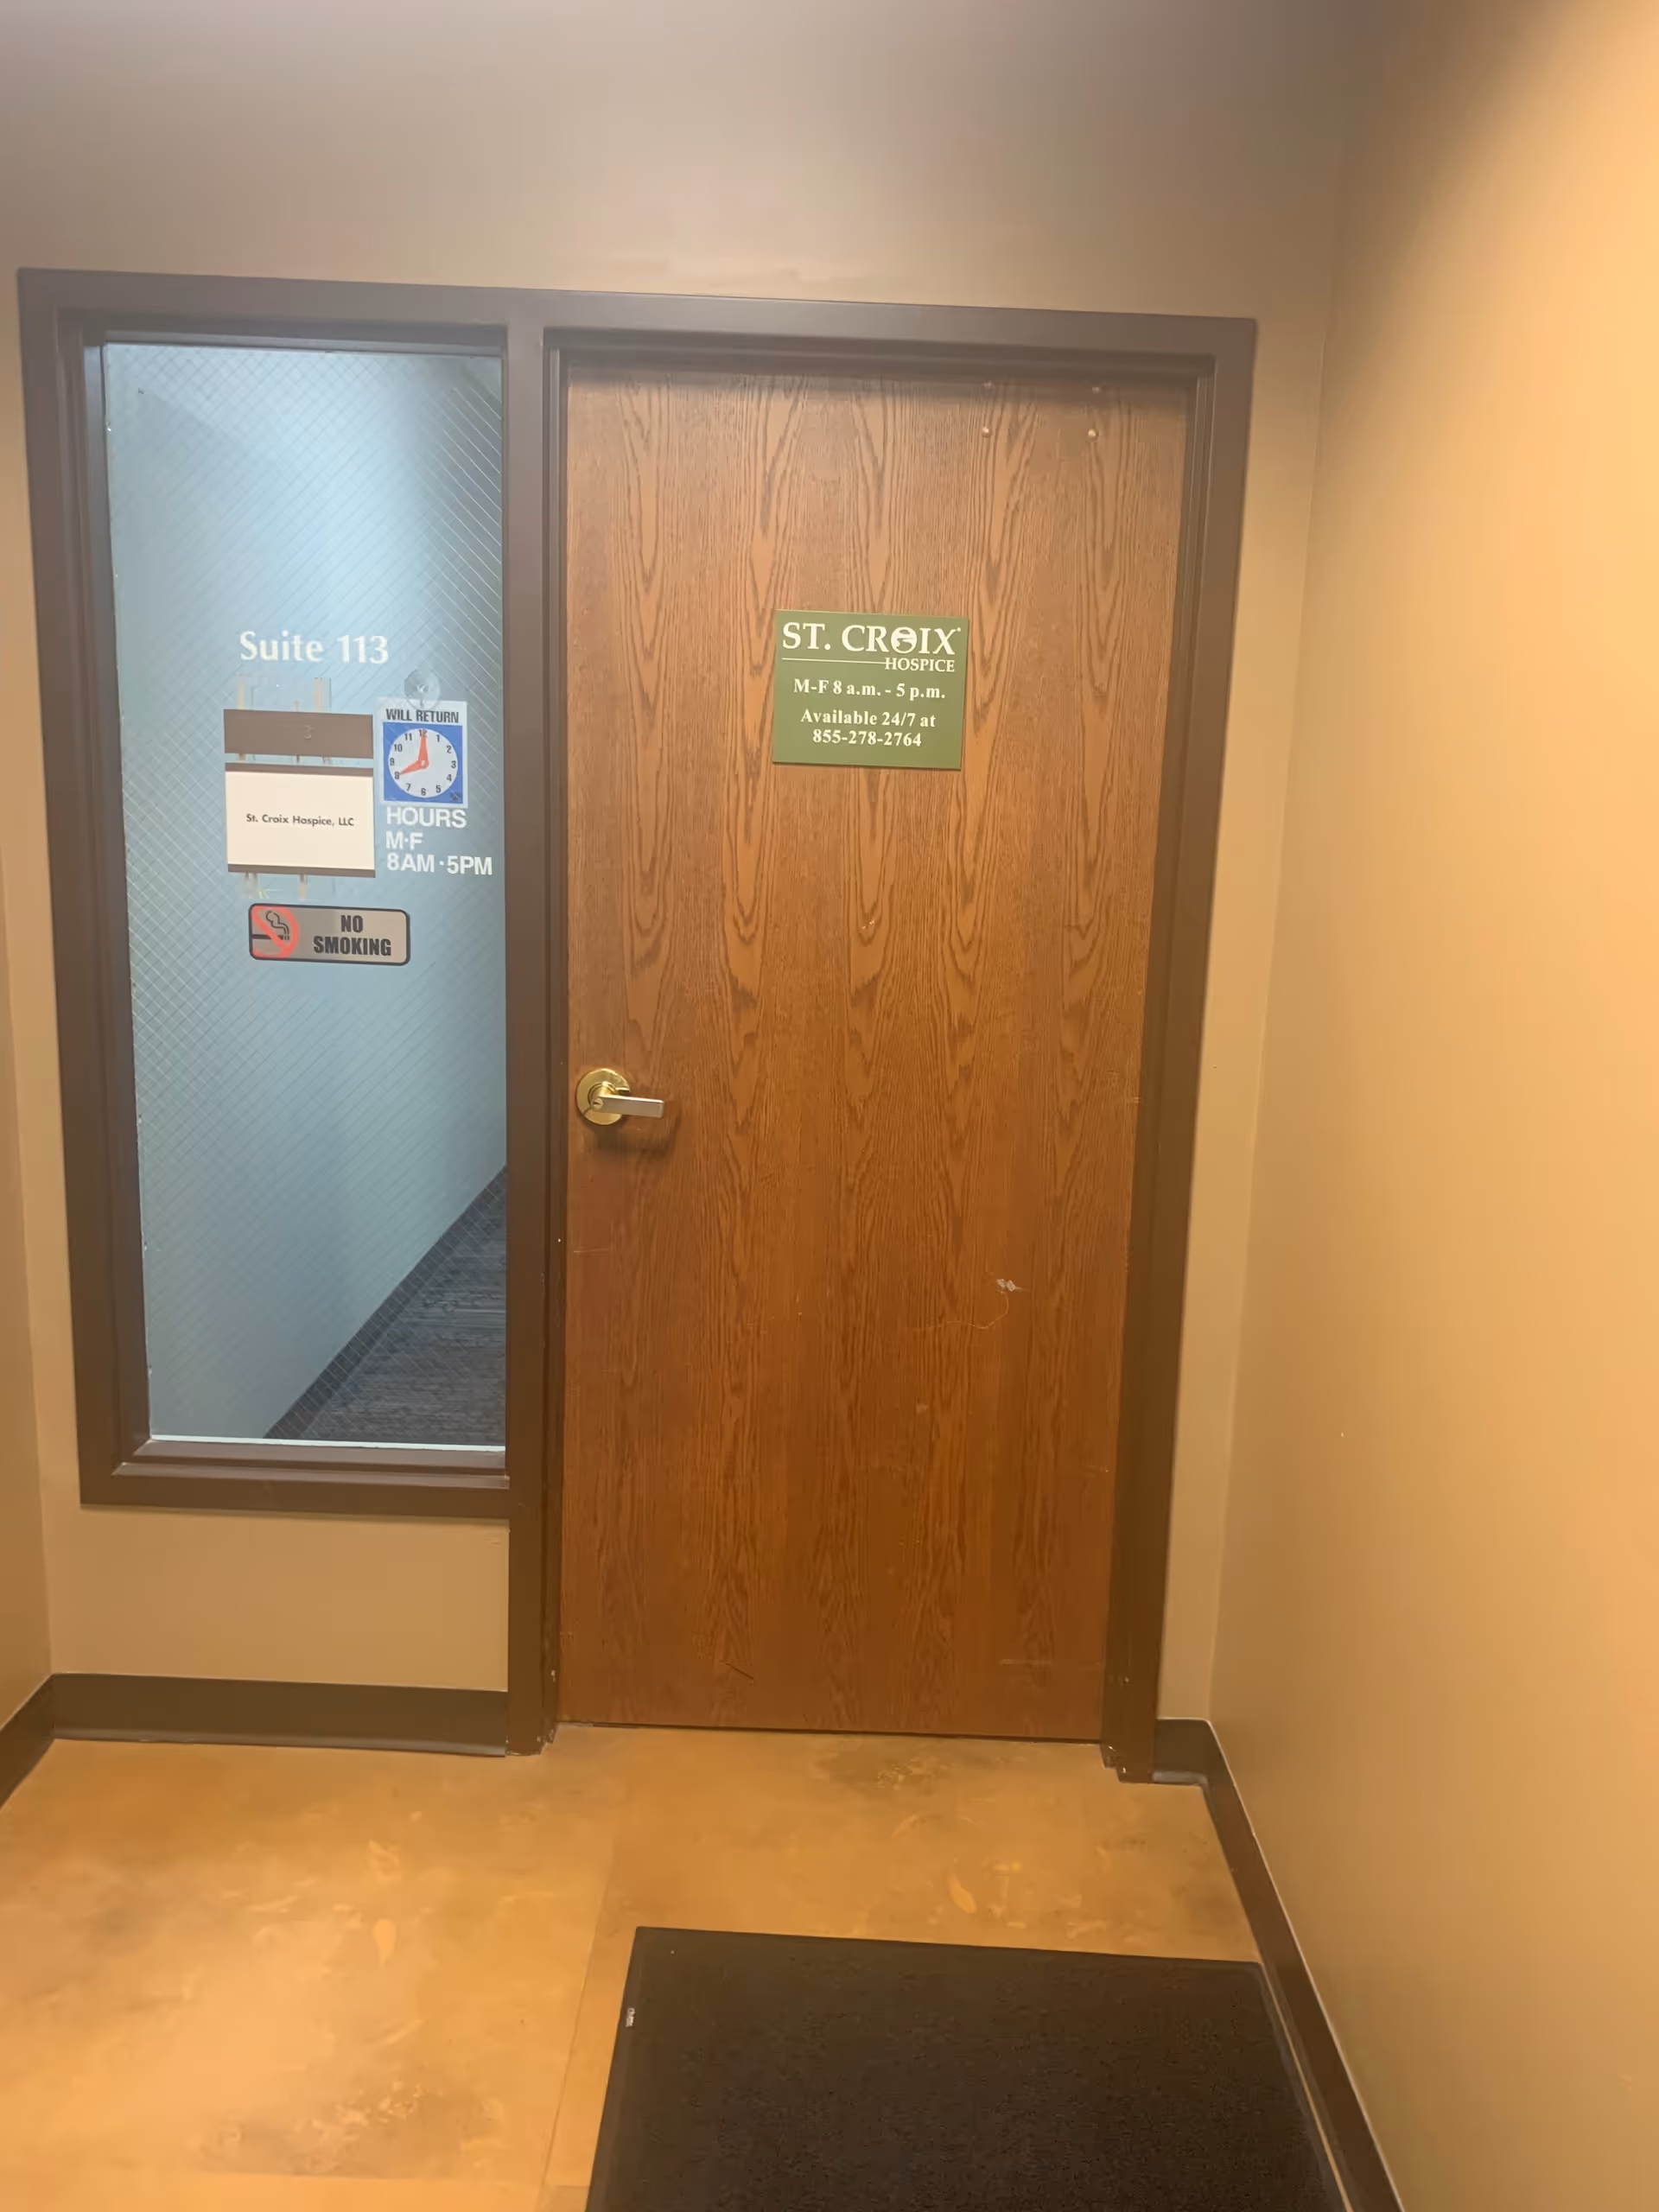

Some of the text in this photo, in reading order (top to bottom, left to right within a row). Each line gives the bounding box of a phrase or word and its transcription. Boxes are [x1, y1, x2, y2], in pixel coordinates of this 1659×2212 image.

[782, 621, 956, 655] ST. CROIX
[239, 629, 390, 664] Suite 113
[884, 657, 956, 673] HOSPICE
[793, 678, 830, 694] M-F
[832, 680, 842, 695] 8
[846, 683, 881, 696] a.m.
[896, 683, 906, 697] 5
[909, 686, 946, 702] p.m.
[385, 709, 459, 724] WILL RETURN
[800, 709, 937, 728] Available 24/7 at
[404, 733, 412, 741] 11
[436, 734, 440, 743] 1
[812, 728, 922, 747] 855-278-2764
[394, 744, 403, 753] 10
[446, 745, 452, 754] 2
[390, 758, 395, 766] 9
[451, 760, 456, 769] 3
[394, 772, 400, 780] 8
[446, 774, 453, 783] 4
[406, 783, 411, 792] 7
[421, 787, 426, 797] 6
[435, 785, 442, 793] 5
[246, 813, 354, 828] St. Croix Hospice, LLC
[386, 807, 467, 829] HOURS
[340, 915, 363, 933] NO
[313, 936, 391, 956] SMOKING
